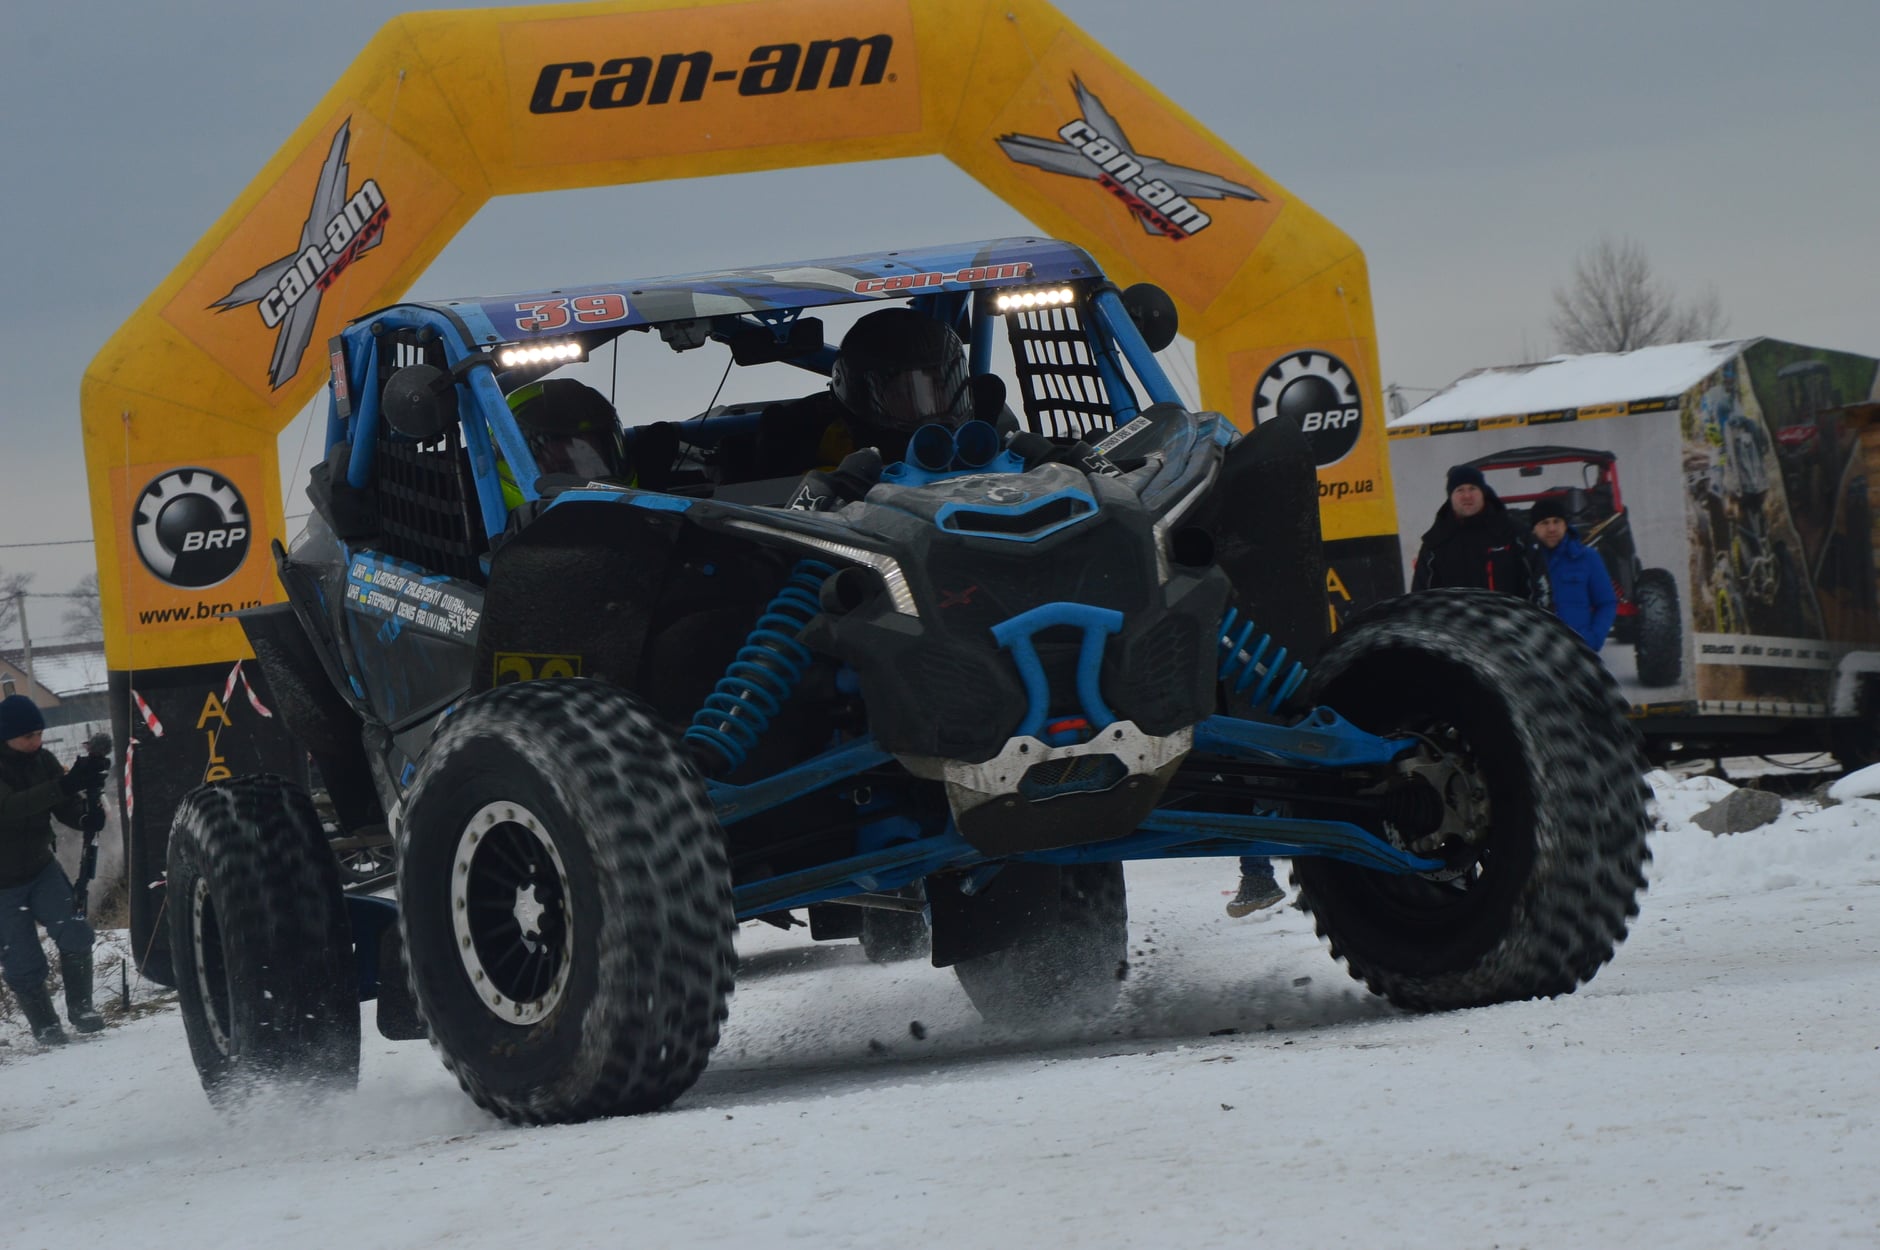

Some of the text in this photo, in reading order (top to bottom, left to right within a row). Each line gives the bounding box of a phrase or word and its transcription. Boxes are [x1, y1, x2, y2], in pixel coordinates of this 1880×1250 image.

[529, 34, 893, 114] can-am
[1058, 119, 1212, 235] can-am
[1099, 173, 1189, 241] TEAM
[258, 179, 385, 328] can-am
[316, 204, 391, 291] TEAM
[854, 262, 1032, 294] can-am
[515, 294, 629, 332] 39
[1302, 408, 1359, 432] BRP
[182, 528, 247, 552] BRP
